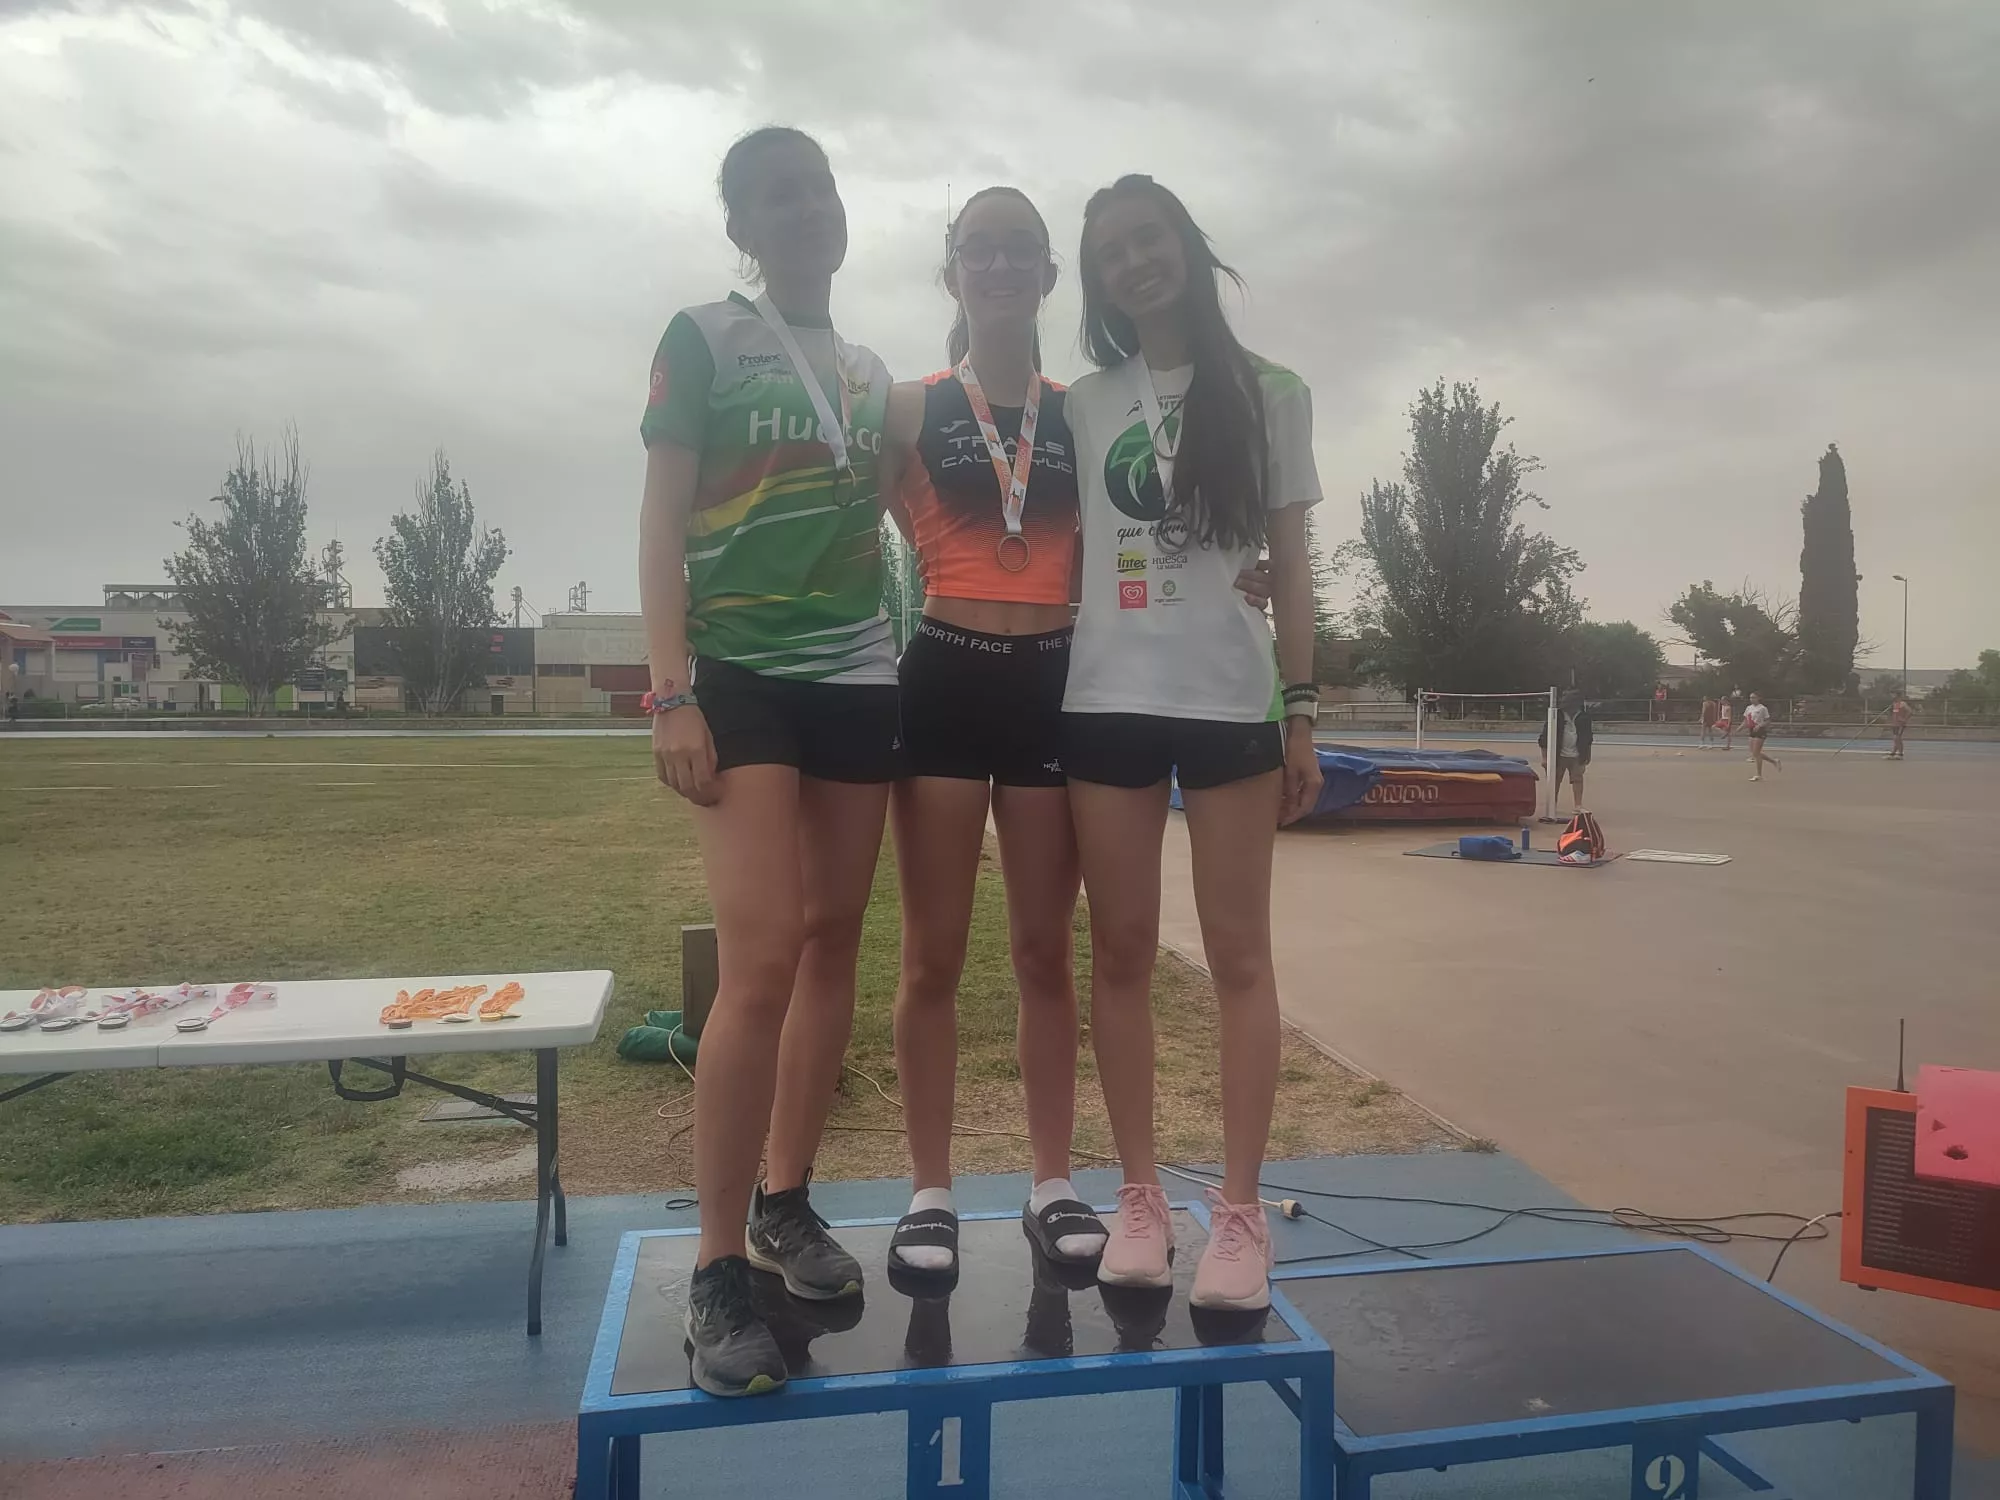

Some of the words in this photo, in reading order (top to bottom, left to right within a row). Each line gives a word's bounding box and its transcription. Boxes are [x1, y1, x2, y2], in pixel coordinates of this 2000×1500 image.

[918, 622, 966, 646] NORTH
[969, 637, 1014, 655] FACE
[1037, 636, 1064, 652] THE
[1353, 783, 1440, 804] ONDO
[929, 1416, 965, 1487] 1
